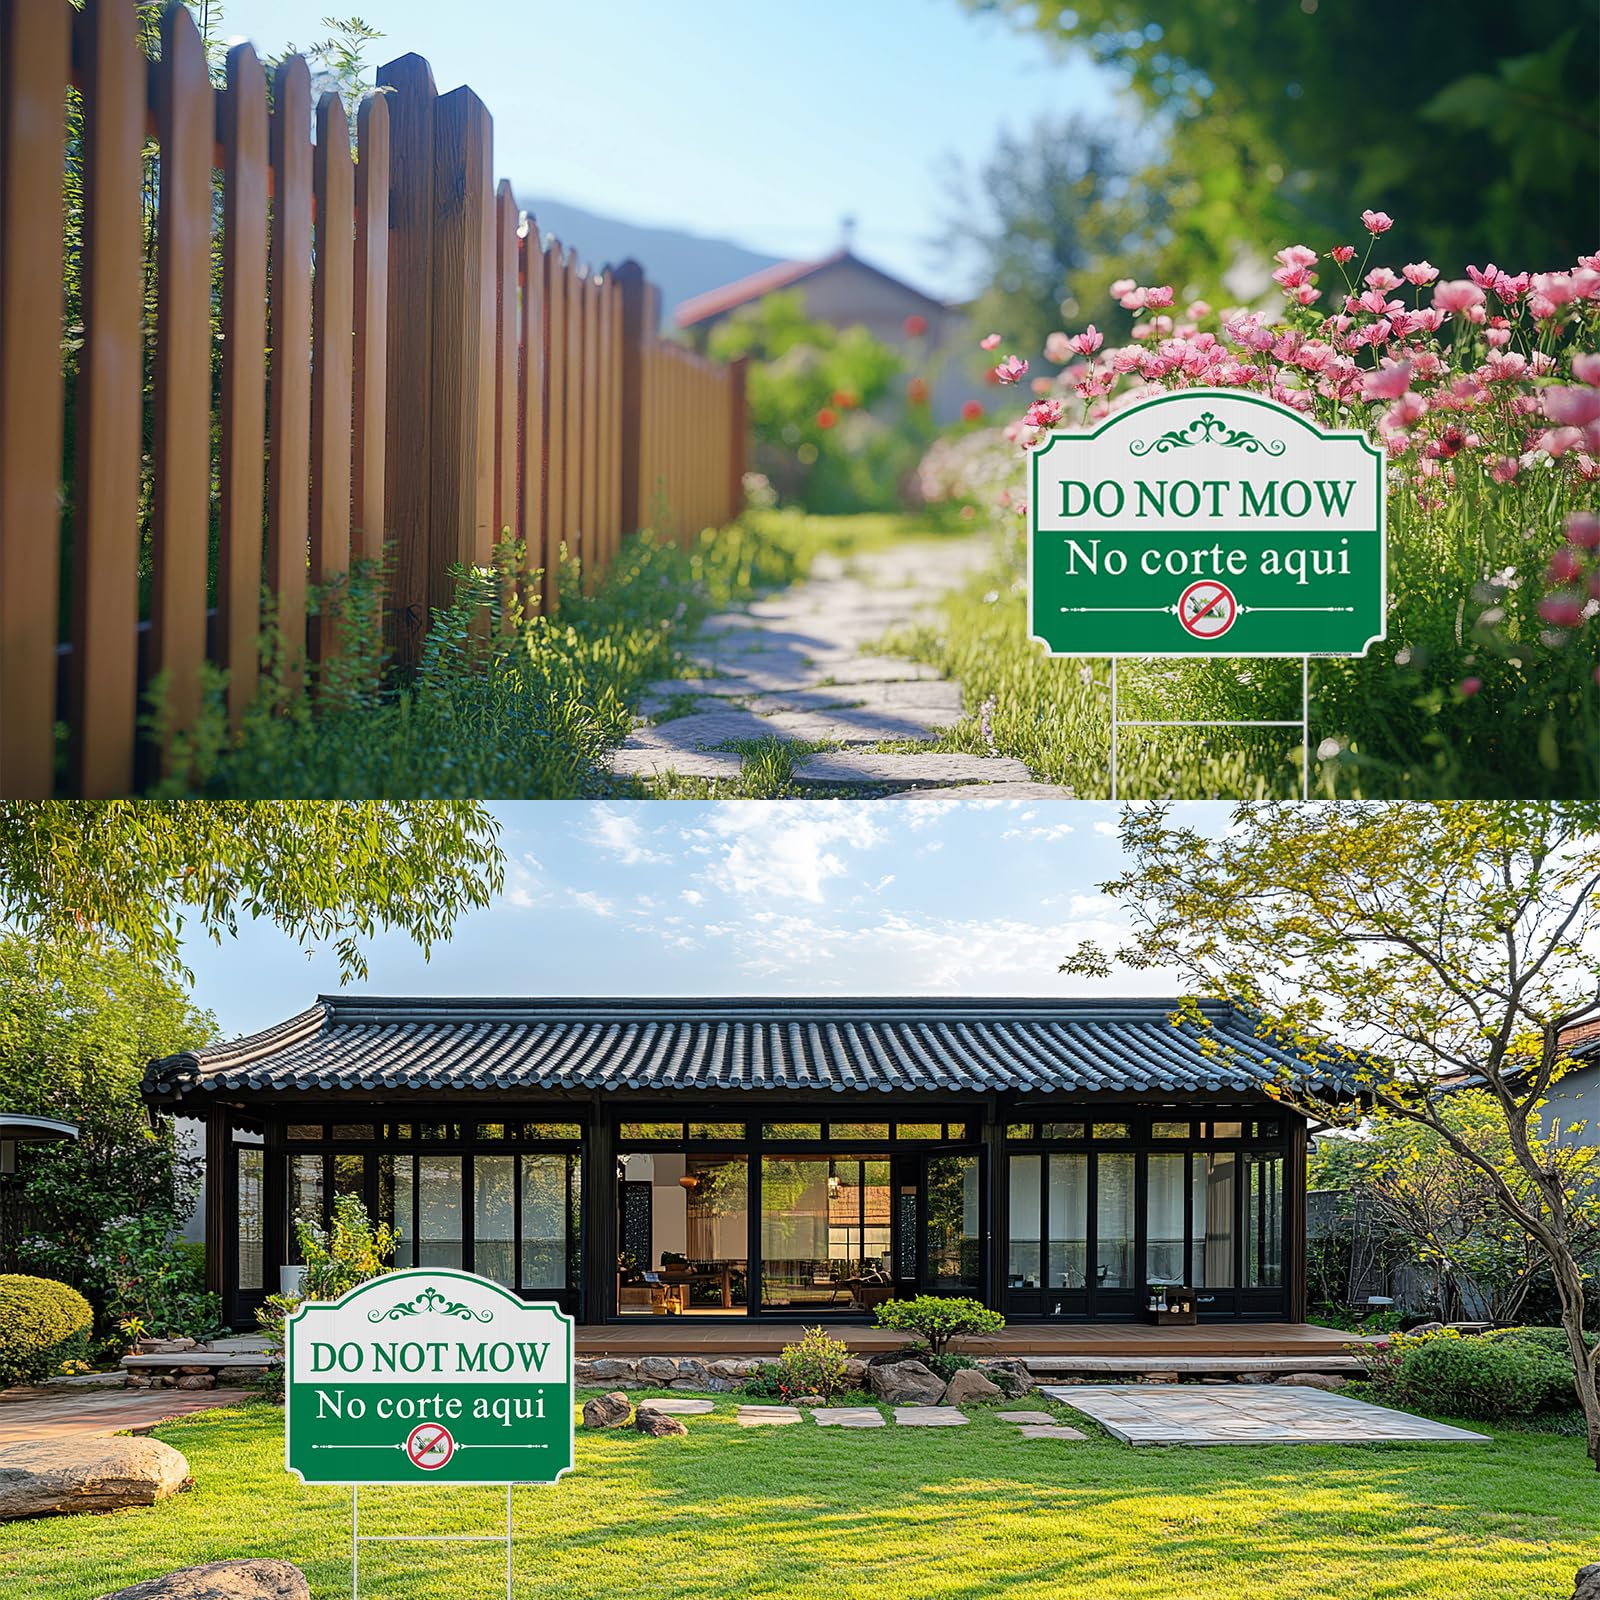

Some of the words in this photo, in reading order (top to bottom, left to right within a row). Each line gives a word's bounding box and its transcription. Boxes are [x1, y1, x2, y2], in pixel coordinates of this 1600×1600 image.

[1058, 480, 1126, 518] DO
[1135, 480, 1230, 518] NOT
[1238, 480, 1357, 518] MOW
[1064, 539, 1128, 576] No
[1140, 542, 1248, 576] corte
[1260, 538, 1351, 585] aqui
[310, 1342, 364, 1373] DO
[372, 1342, 449, 1373] NOT
[455, 1342, 550, 1373] MOW
[315, 1390, 367, 1419] No
[376, 1392, 463, 1419] corte
[472, 1389, 546, 1427] aqui
